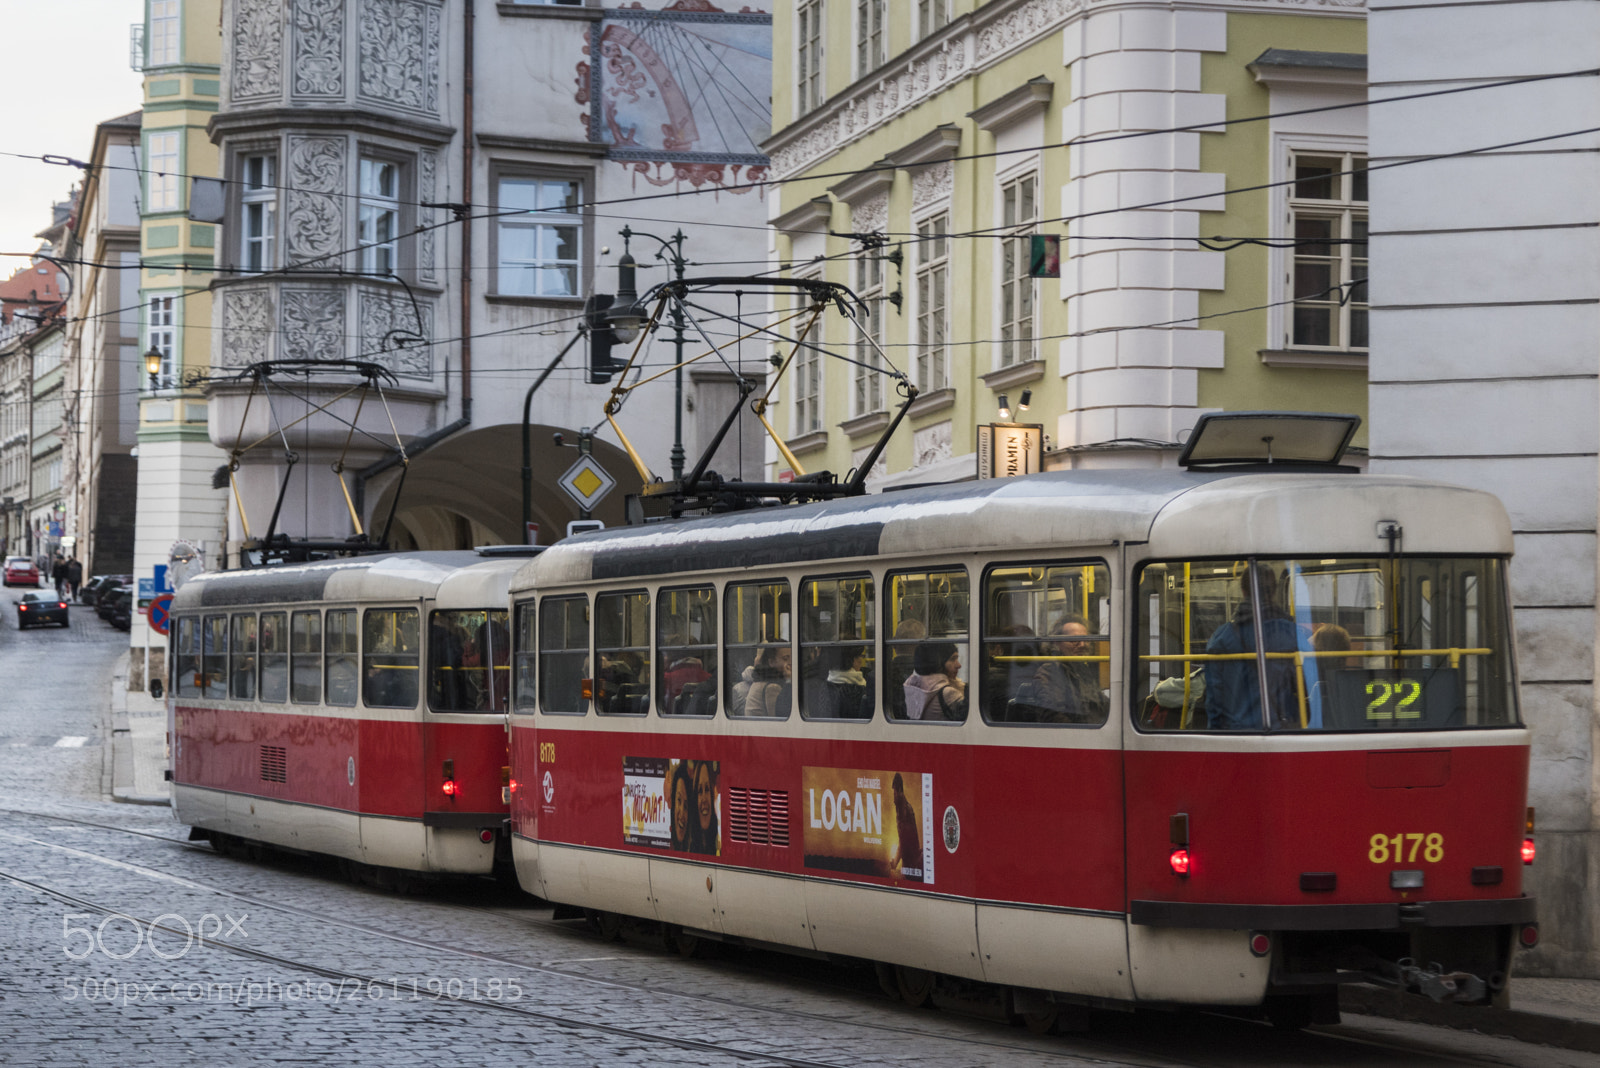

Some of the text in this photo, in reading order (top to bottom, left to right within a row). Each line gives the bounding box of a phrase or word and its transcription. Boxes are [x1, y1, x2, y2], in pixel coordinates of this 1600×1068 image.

[1366, 678, 1421, 720] 22
[540, 742, 556, 763] 8178
[809, 788, 882, 835] LOGAN
[1368, 832, 1444, 864] 8178
